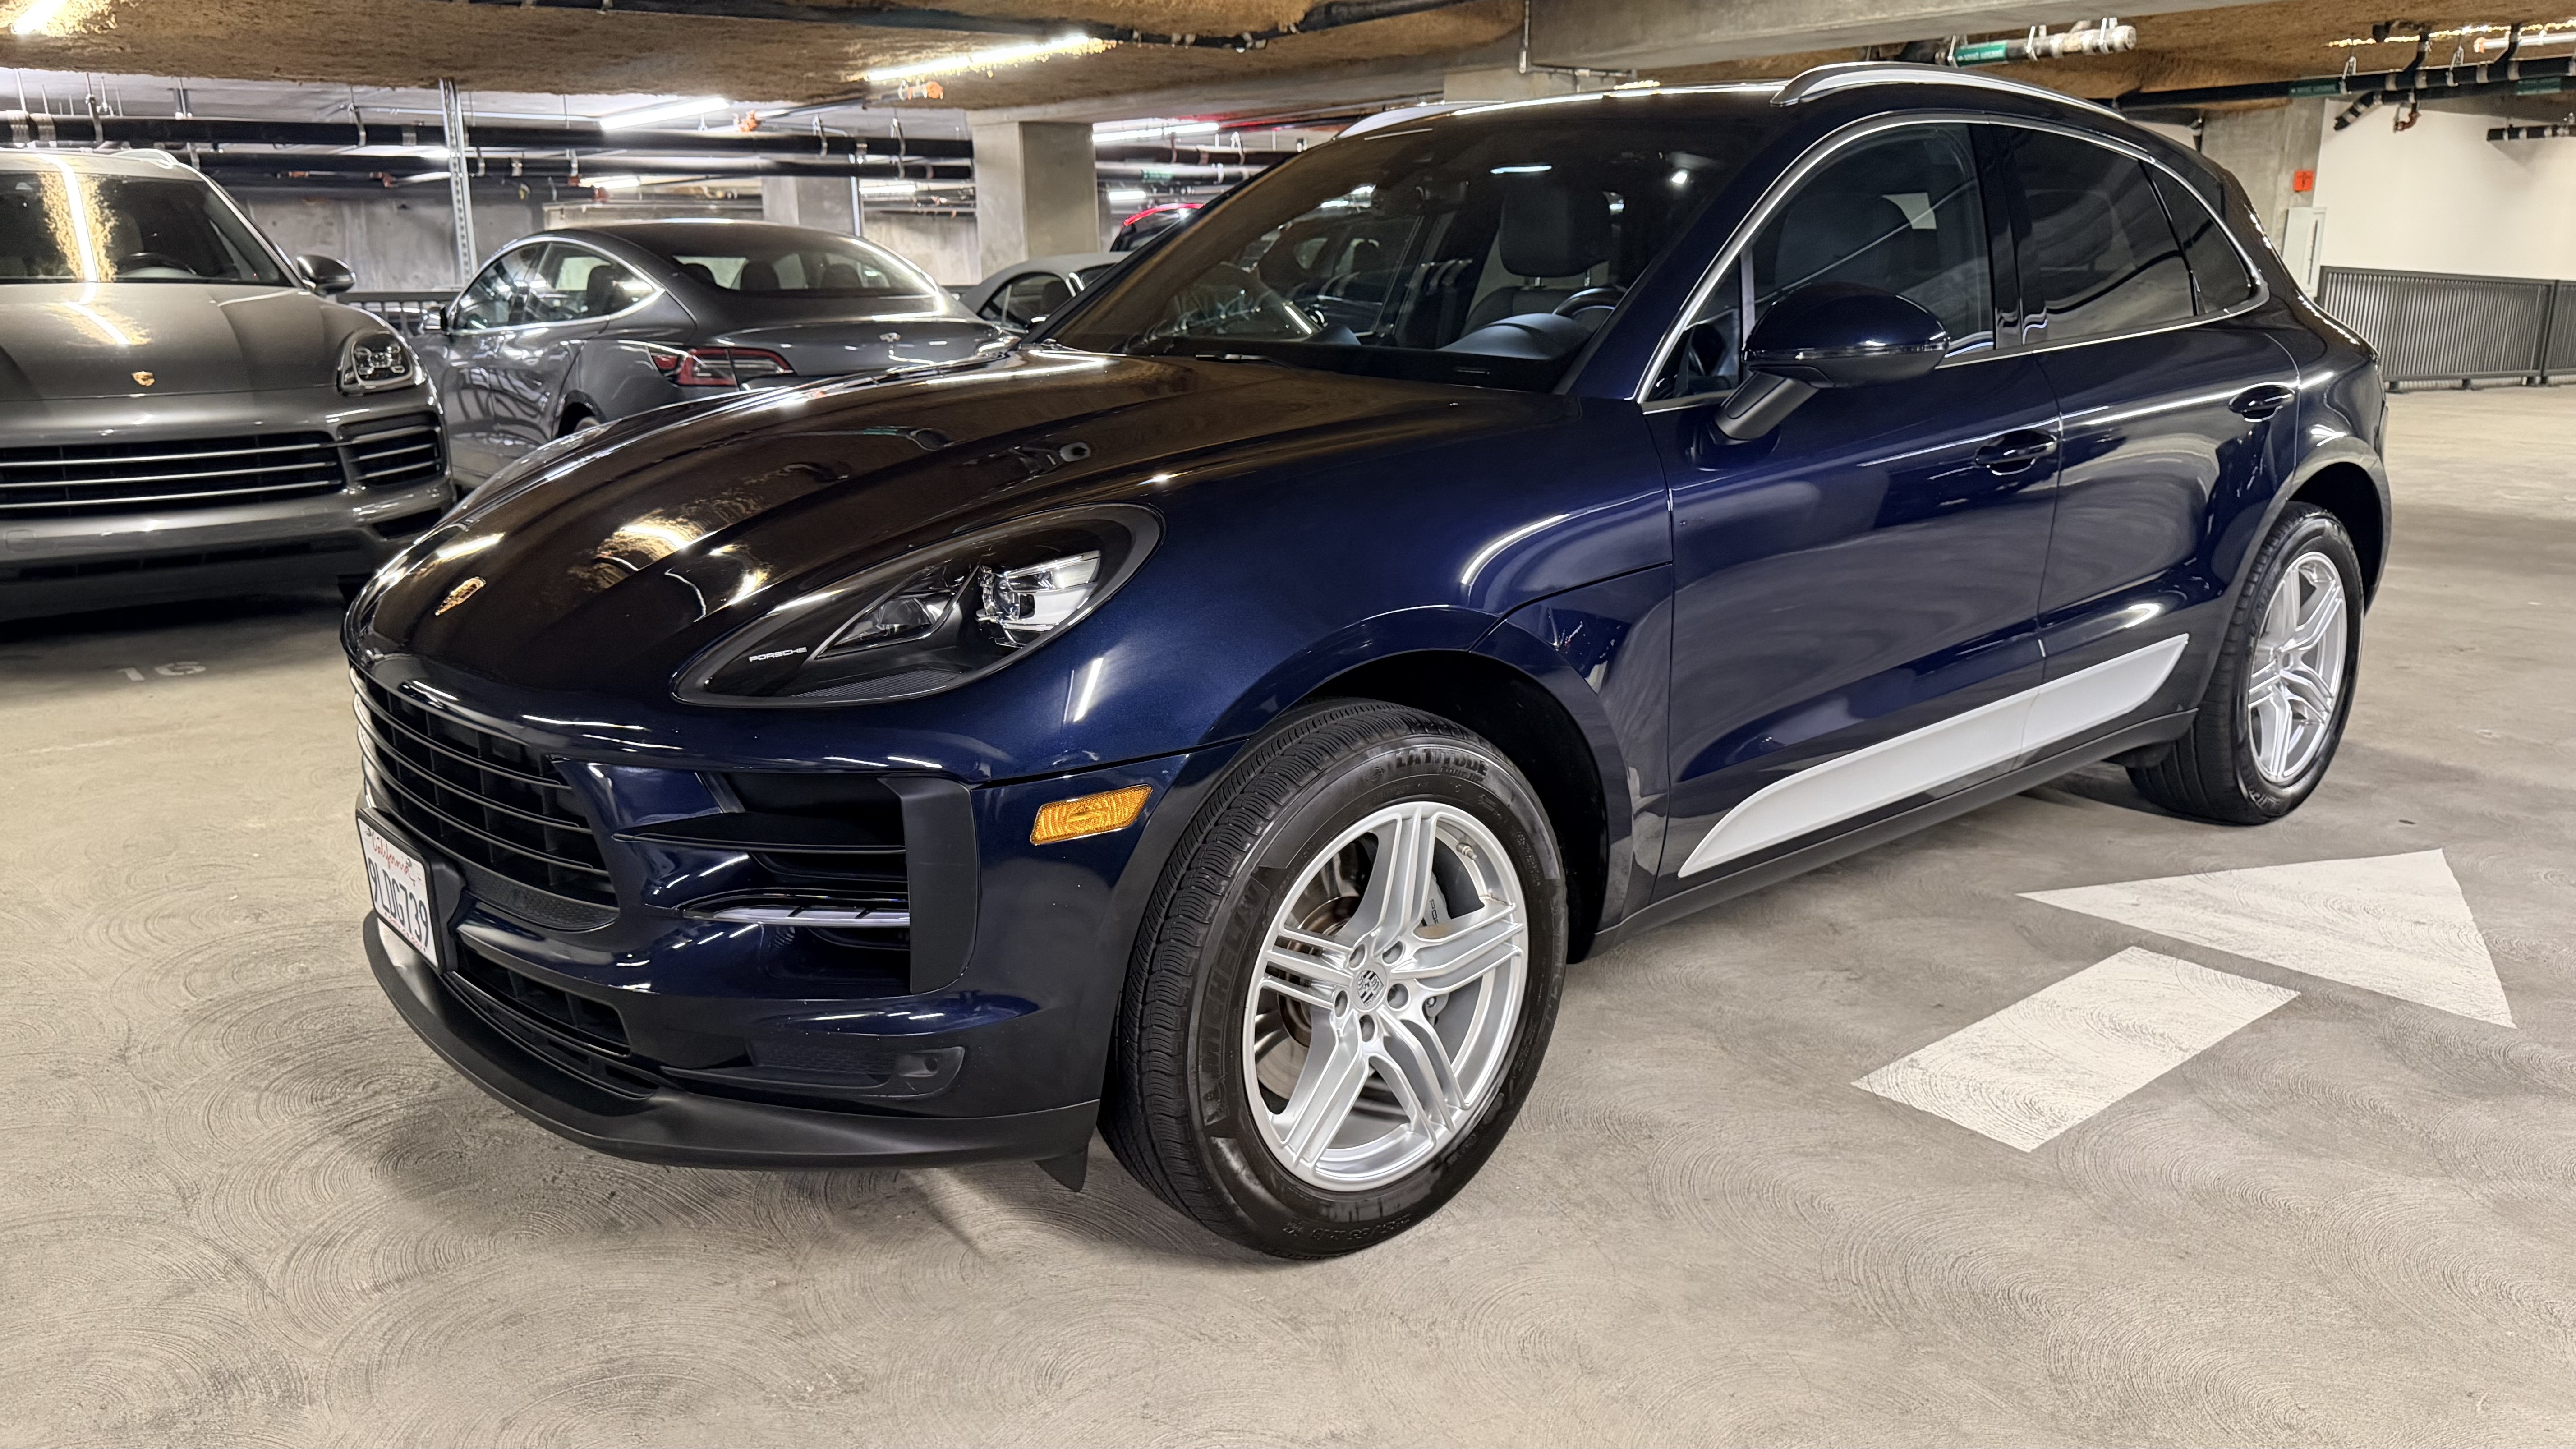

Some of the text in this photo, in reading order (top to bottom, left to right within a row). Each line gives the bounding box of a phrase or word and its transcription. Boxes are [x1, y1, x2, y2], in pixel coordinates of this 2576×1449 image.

[116, 661, 207, 681] 16
[749, 647, 807, 662] PORSCHE
[1395, 749, 1489, 776] LATITUDE
[371, 829, 412, 877] California
[368, 857, 429, 948] 9LDG739
[1198, 876, 1268, 1076] MICHELIN
